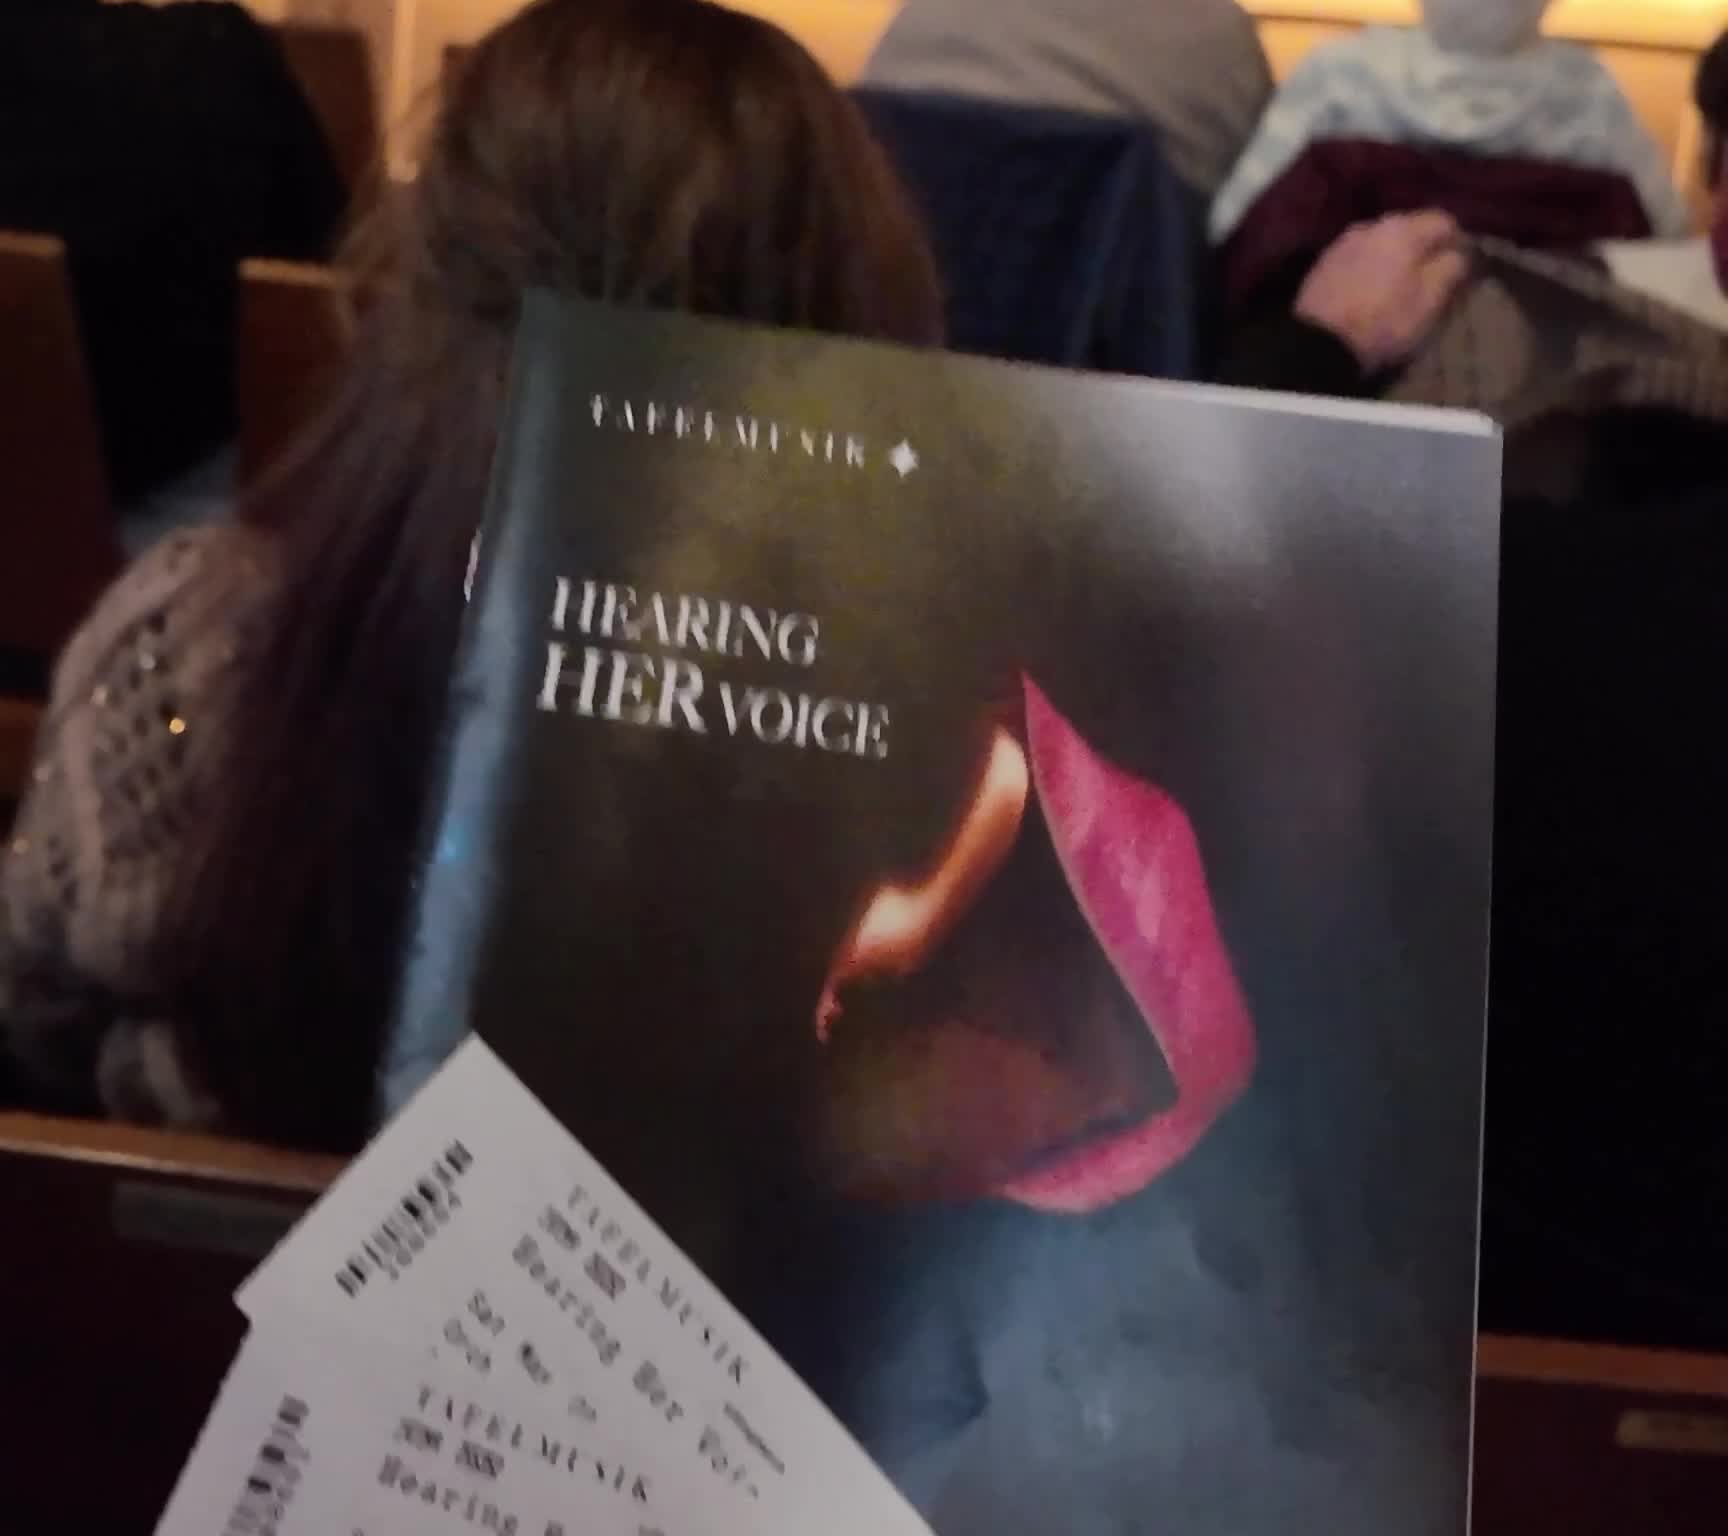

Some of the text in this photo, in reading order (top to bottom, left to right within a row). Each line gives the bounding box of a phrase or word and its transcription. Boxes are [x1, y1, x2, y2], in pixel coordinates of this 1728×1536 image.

[551, 575, 820, 668] HEARING
[536, 641, 890, 760] HER VOICE
